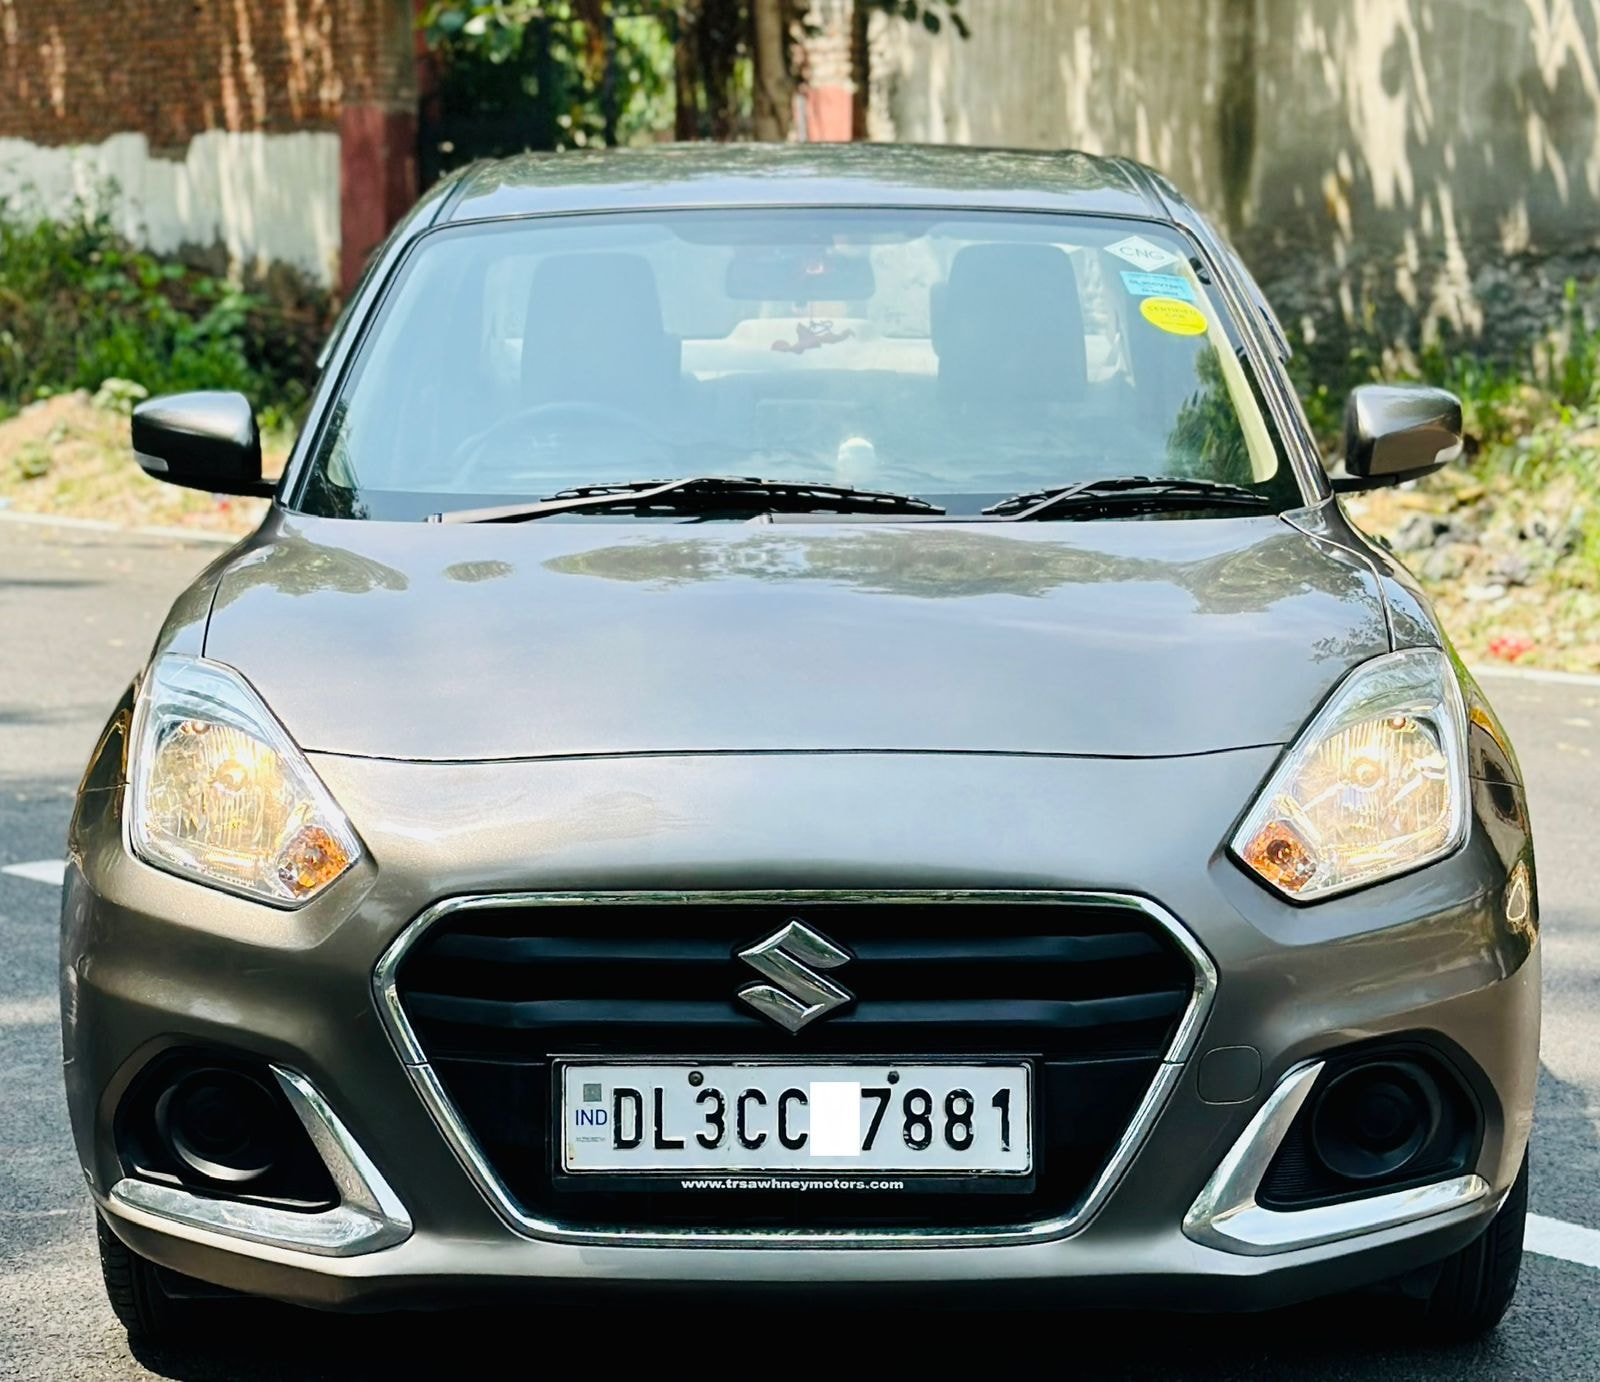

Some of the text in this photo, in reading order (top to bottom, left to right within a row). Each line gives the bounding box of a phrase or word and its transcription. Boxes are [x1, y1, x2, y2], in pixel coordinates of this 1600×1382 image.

[1119, 246, 1165, 261] CNG
[575, 1108, 608, 1126] IND
[612, 1086, 1012, 1152] DL3CC7881
[681, 1178, 905, 1191] www.trsawhneymotors.com
